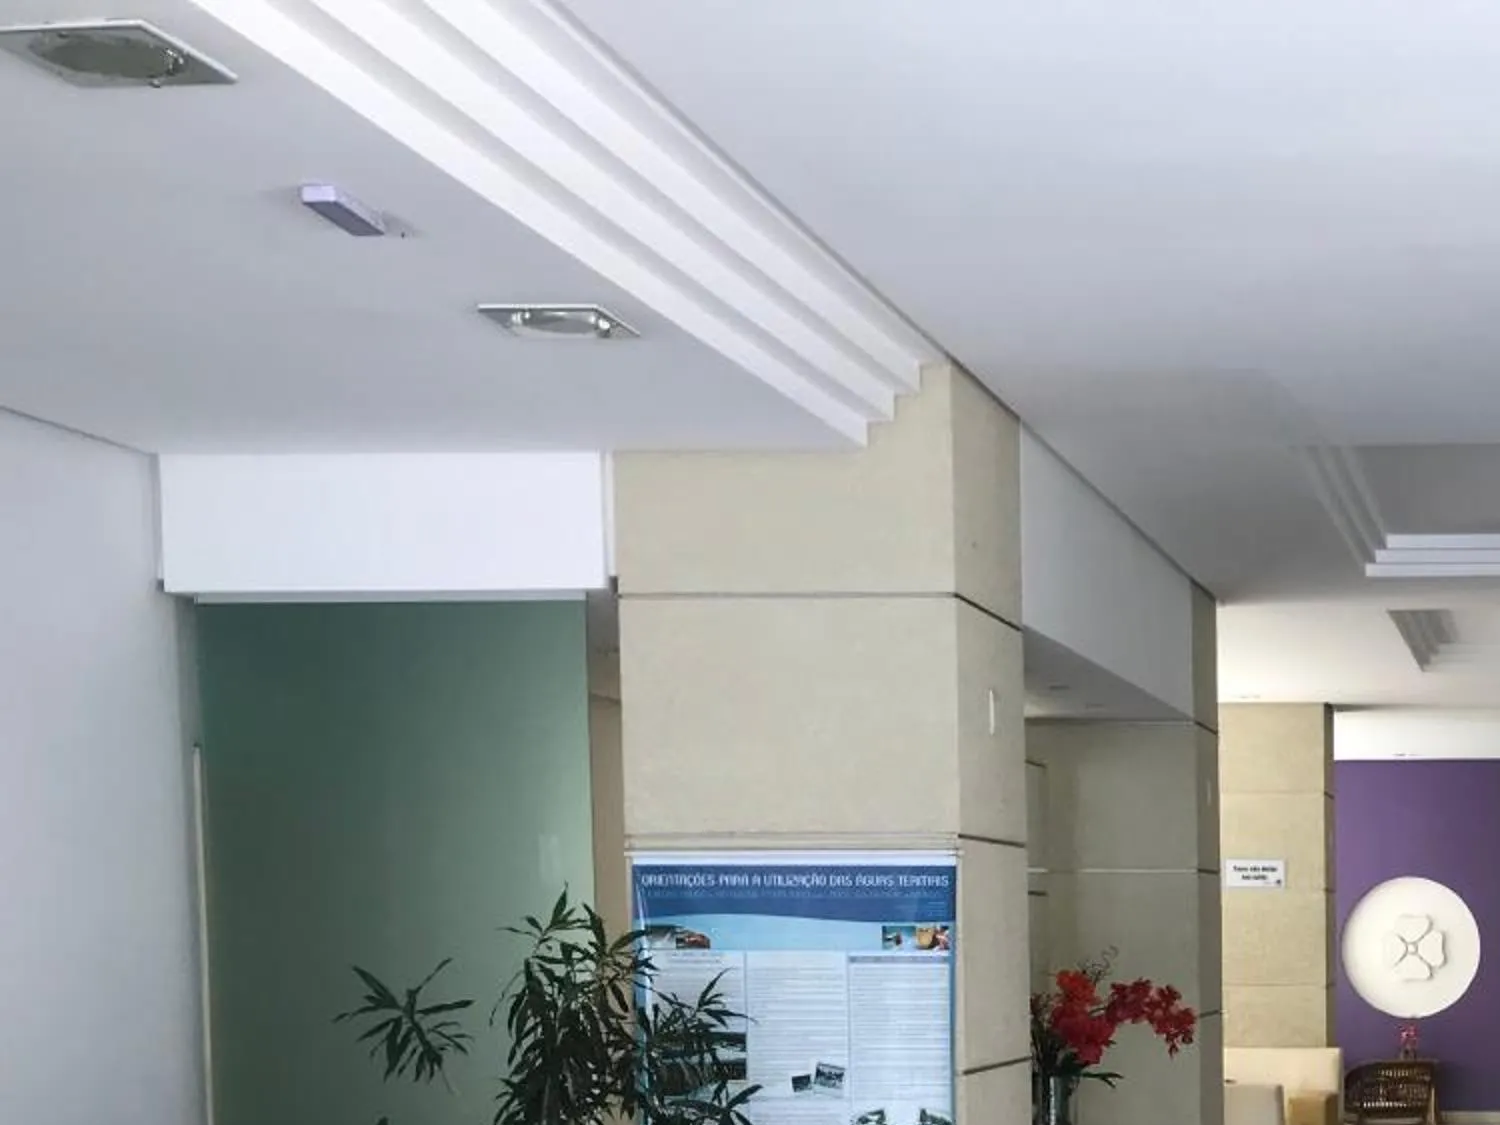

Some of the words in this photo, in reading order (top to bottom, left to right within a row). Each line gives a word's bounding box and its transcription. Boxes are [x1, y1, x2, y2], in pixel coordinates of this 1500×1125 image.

[641, 872, 715, 887] ORIENTAÇÕES
[718, 874, 749, 886] PARA
[751, 874, 761, 886] A
[763, 872, 827, 888] UTILIZAÇÃO
[829, 874, 853, 887] DAS
[855, 872, 895, 887] ÁGUAS
[898, 874, 949, 887] TERMAIS
